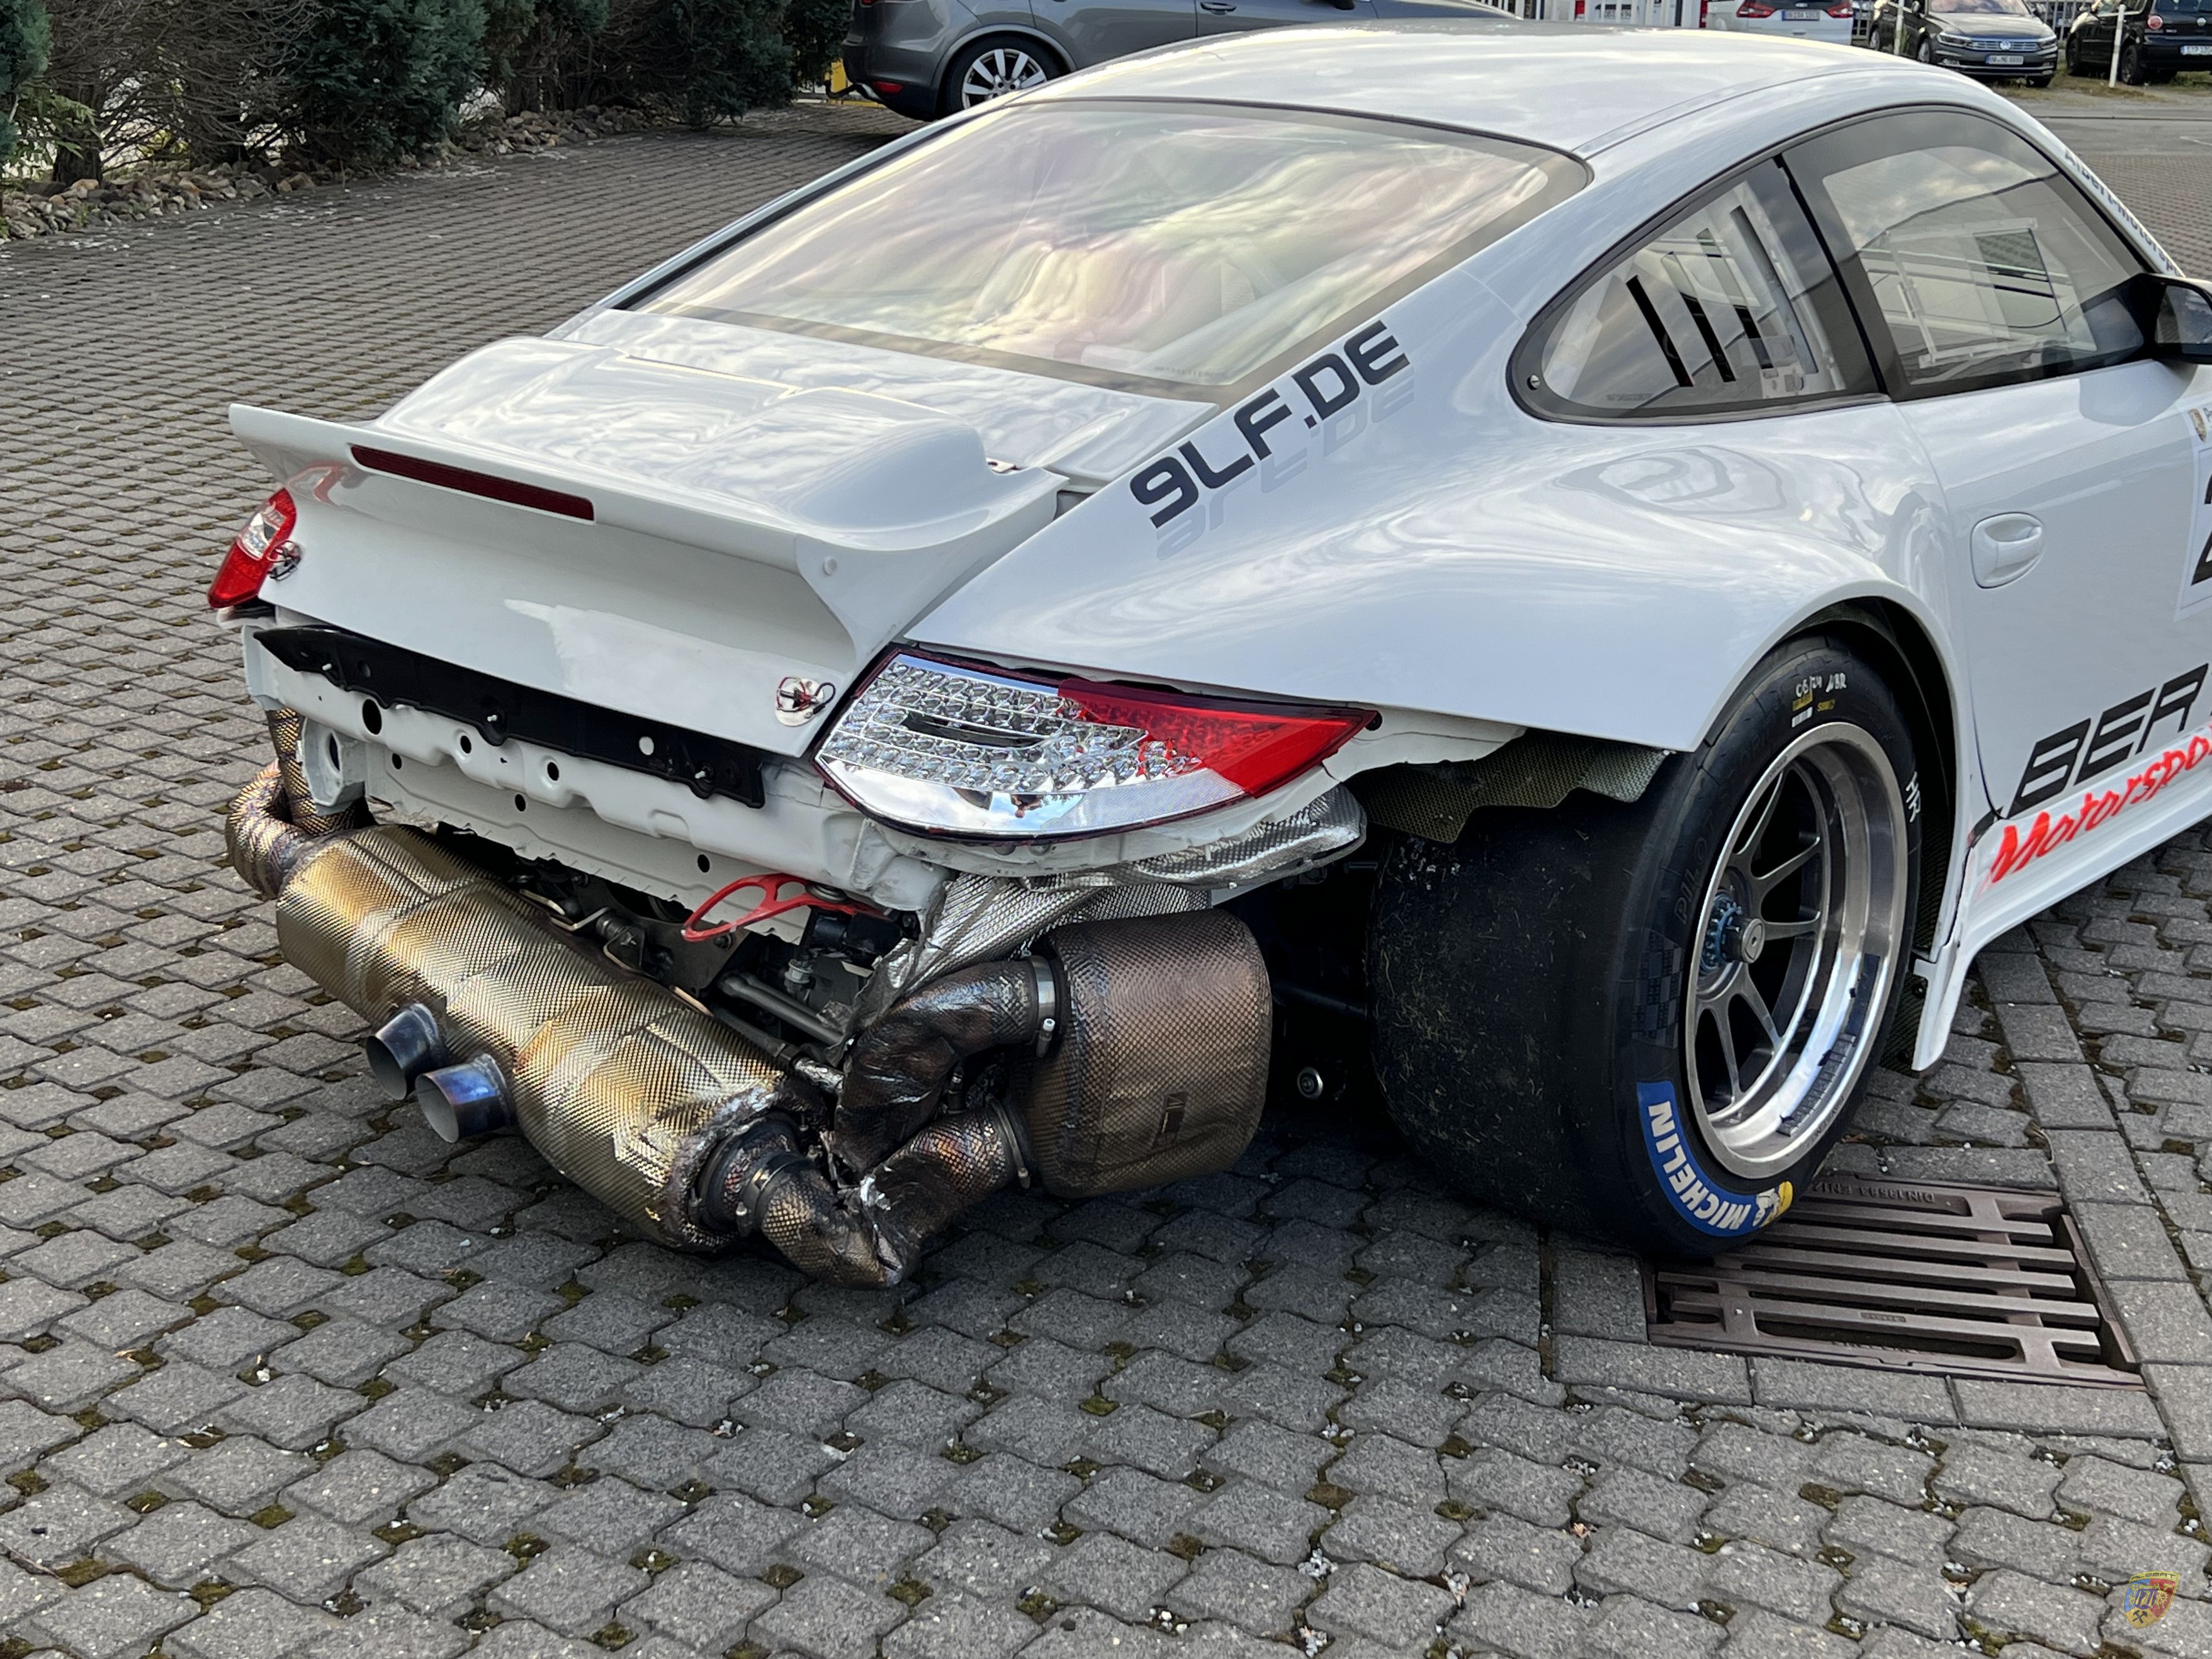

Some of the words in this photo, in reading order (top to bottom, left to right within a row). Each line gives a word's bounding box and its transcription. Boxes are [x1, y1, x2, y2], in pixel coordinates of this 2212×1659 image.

[1130, 319, 1410, 529] 9LF.DE
[1990, 724, 2212, 884] Motorspo
[1648, 1101, 1751, 1230] MICHELIN
